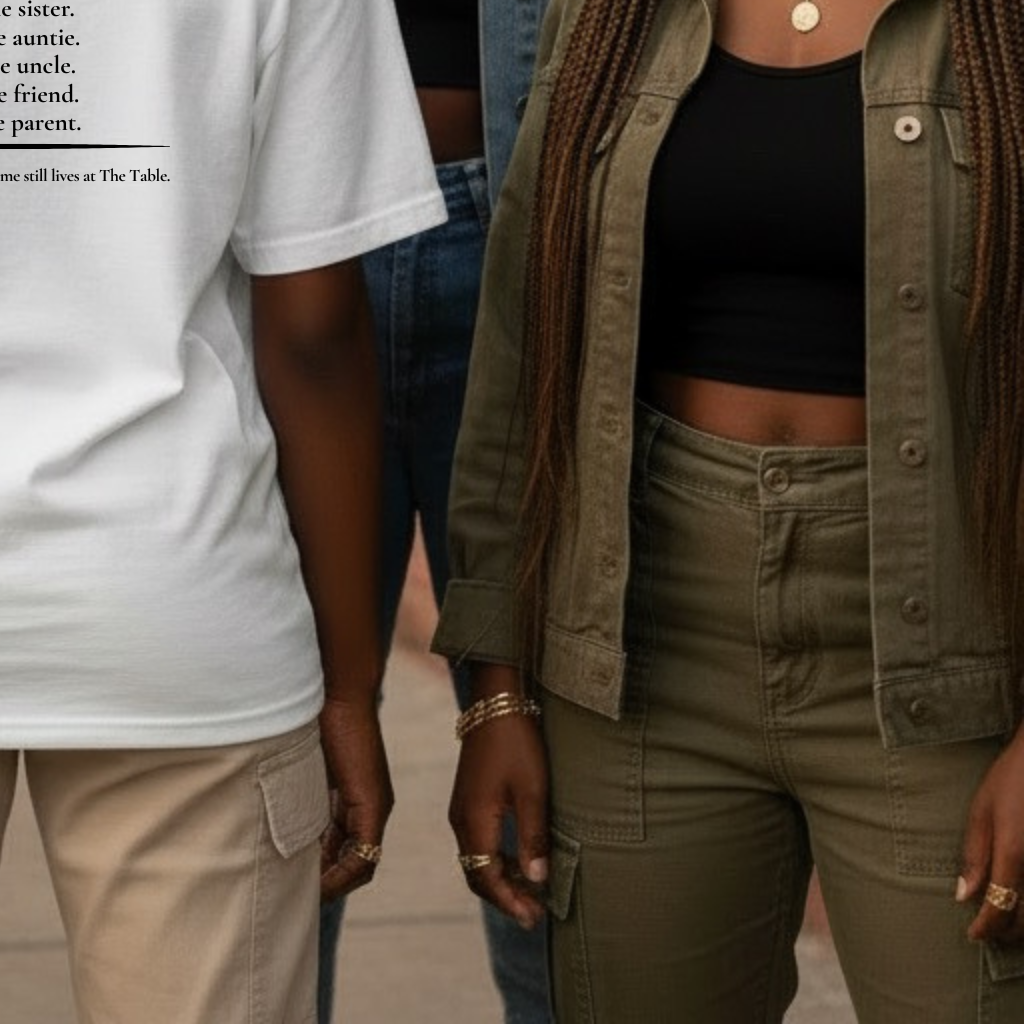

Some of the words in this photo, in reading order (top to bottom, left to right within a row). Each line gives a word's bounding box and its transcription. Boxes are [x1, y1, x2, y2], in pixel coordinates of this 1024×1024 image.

[18, 0, 75, 17] sister.
[12, 28, 80, 46] auntie.
[16, 54, 76, 74] uncle.
[13, 82, 79, 103] friend.
[10, 118, 82, 138] parent.
[23, 167, 48, 182] still
[51, 167, 80, 182] lives
[83, 172, 96, 182] at
[99, 167, 126, 182] The
[129, 167, 171, 182] Table.
